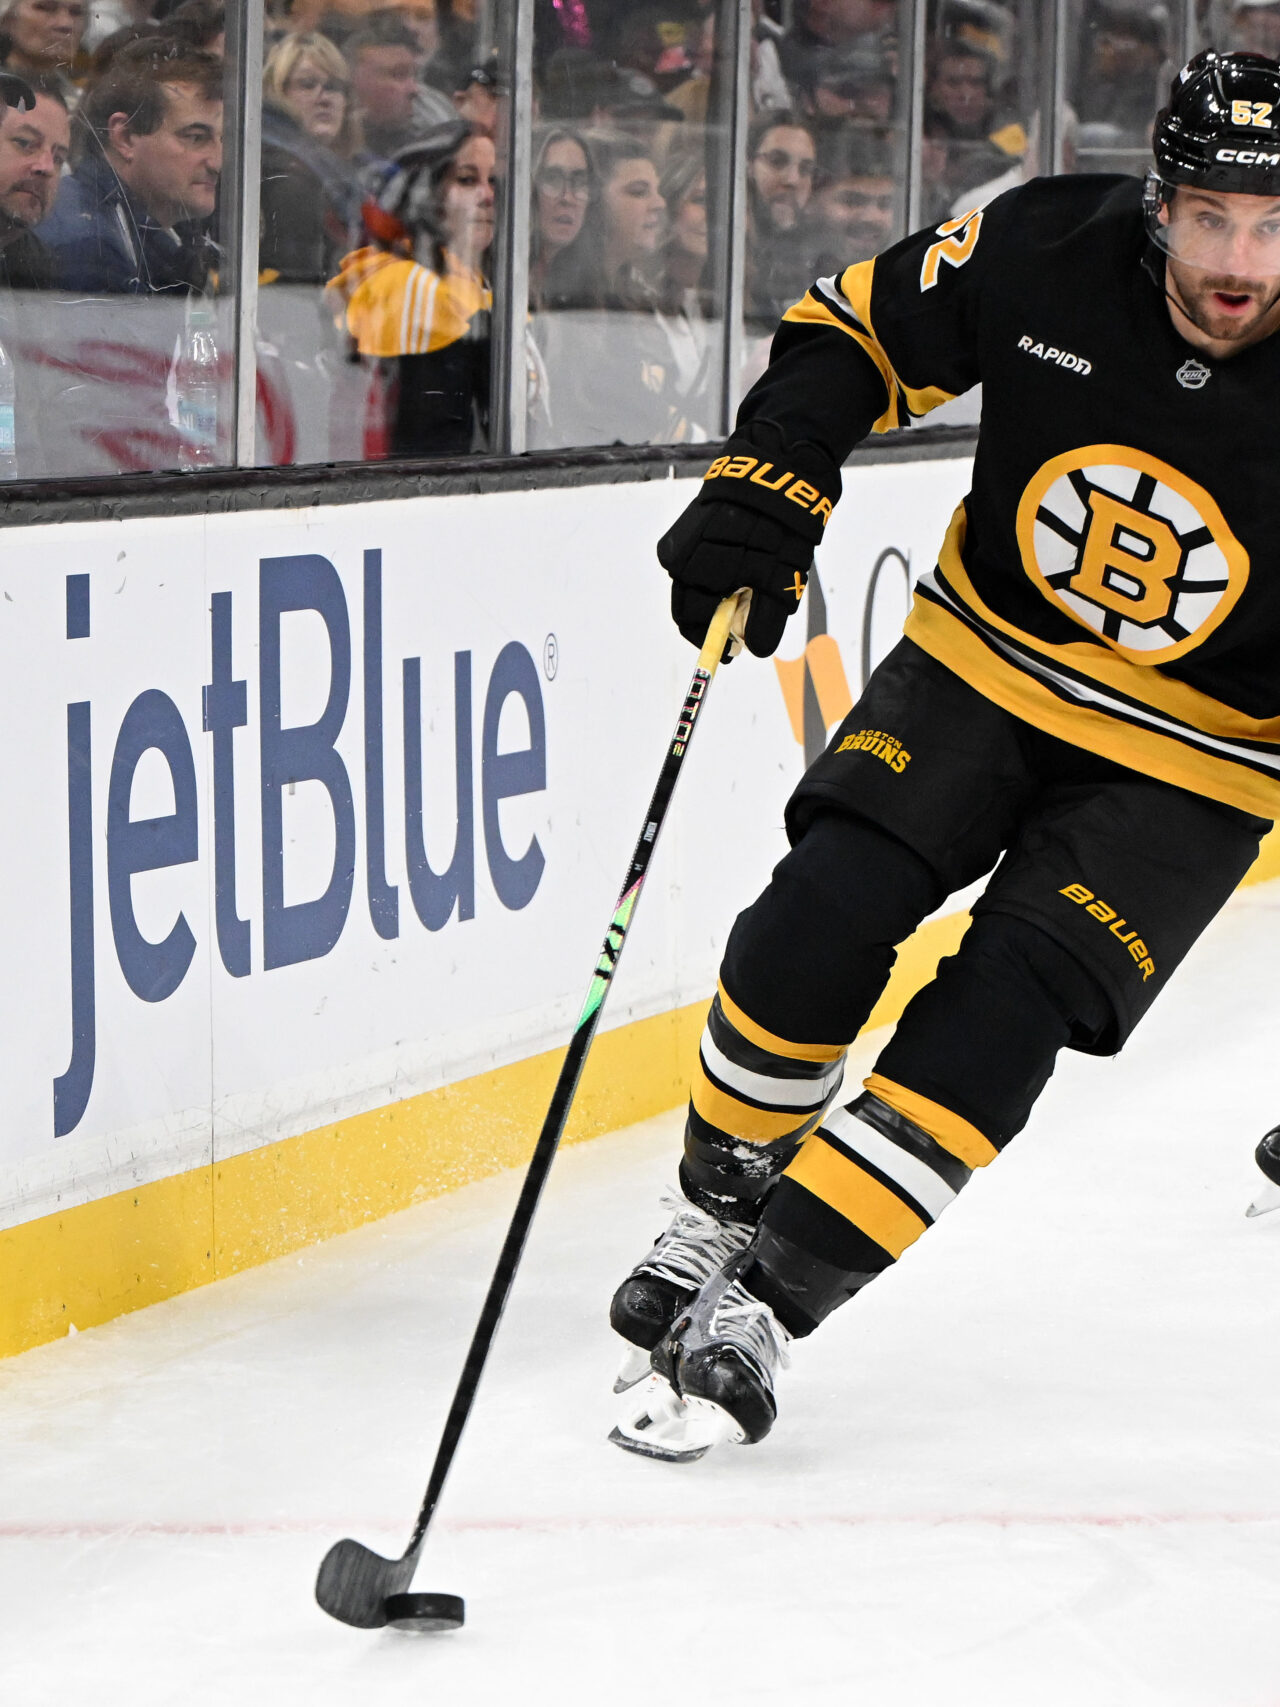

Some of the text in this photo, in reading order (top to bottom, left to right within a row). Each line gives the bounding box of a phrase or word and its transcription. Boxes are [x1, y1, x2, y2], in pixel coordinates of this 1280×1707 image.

[1231, 100, 1273, 129] 52
[1215, 149, 1280, 166] CCM
[704, 455, 833, 527] BAUER
[834, 733, 912, 774] BRUINS
[858, 729, 903, 750] BOSTON
[53, 547, 547, 1138] jetBlue
[1058, 883, 1156, 982] BAUER
